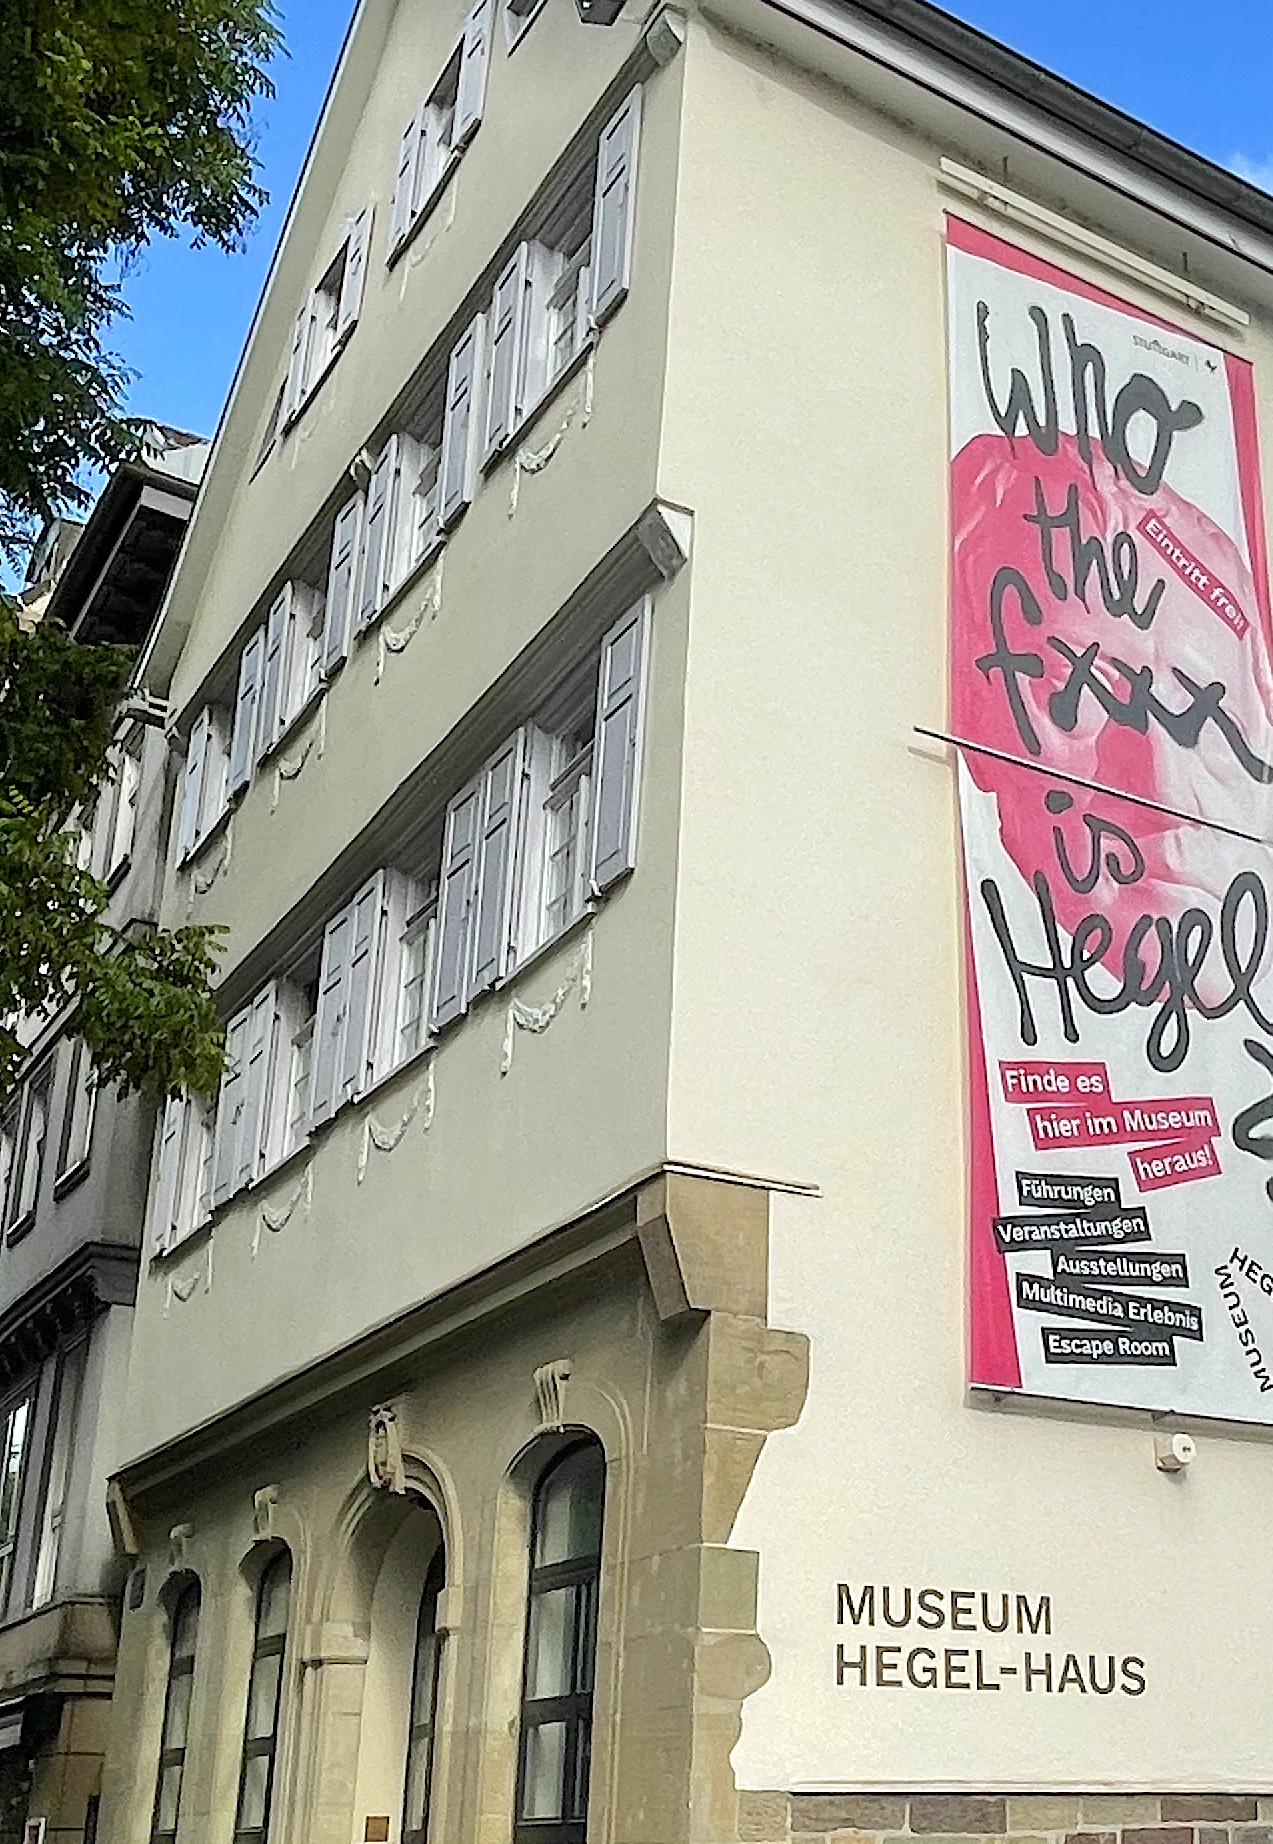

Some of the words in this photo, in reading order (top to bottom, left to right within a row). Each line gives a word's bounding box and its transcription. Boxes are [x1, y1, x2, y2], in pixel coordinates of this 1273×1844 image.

[977, 300, 1204, 496] Who
[1022, 476, 1166, 630] the
[1145, 518, 1211, 592] Eintritt
[1044, 790, 1145, 893] is
[1004, 1069, 1070, 1093] Finde
[1079, 1072, 1104, 1092] es
[1036, 1113, 1080, 1139] hier
[1086, 1114, 1117, 1135] im
[1125, 1107, 1212, 1132] Museum
[1135, 1147, 1213, 1181] heraus!
[1021, 1179, 1116, 1209] Führungen
[997, 1213, 1146, 1242] Veranstaltungen
[1056, 1256, 1184, 1281] Ausstellungen
[1021, 1282, 1124, 1319] Multimedia
[1128, 1301, 1200, 1331] Erlebnis
[1214, 1264, 1273, 1393] MUSEUM
[1048, 1334, 1114, 1358] Escape
[1118, 1336, 1170, 1357] Room
[836, 1583, 1052, 1635] MUSEUM
[836, 1643, 1147, 1697] HEGEL-HAUS
